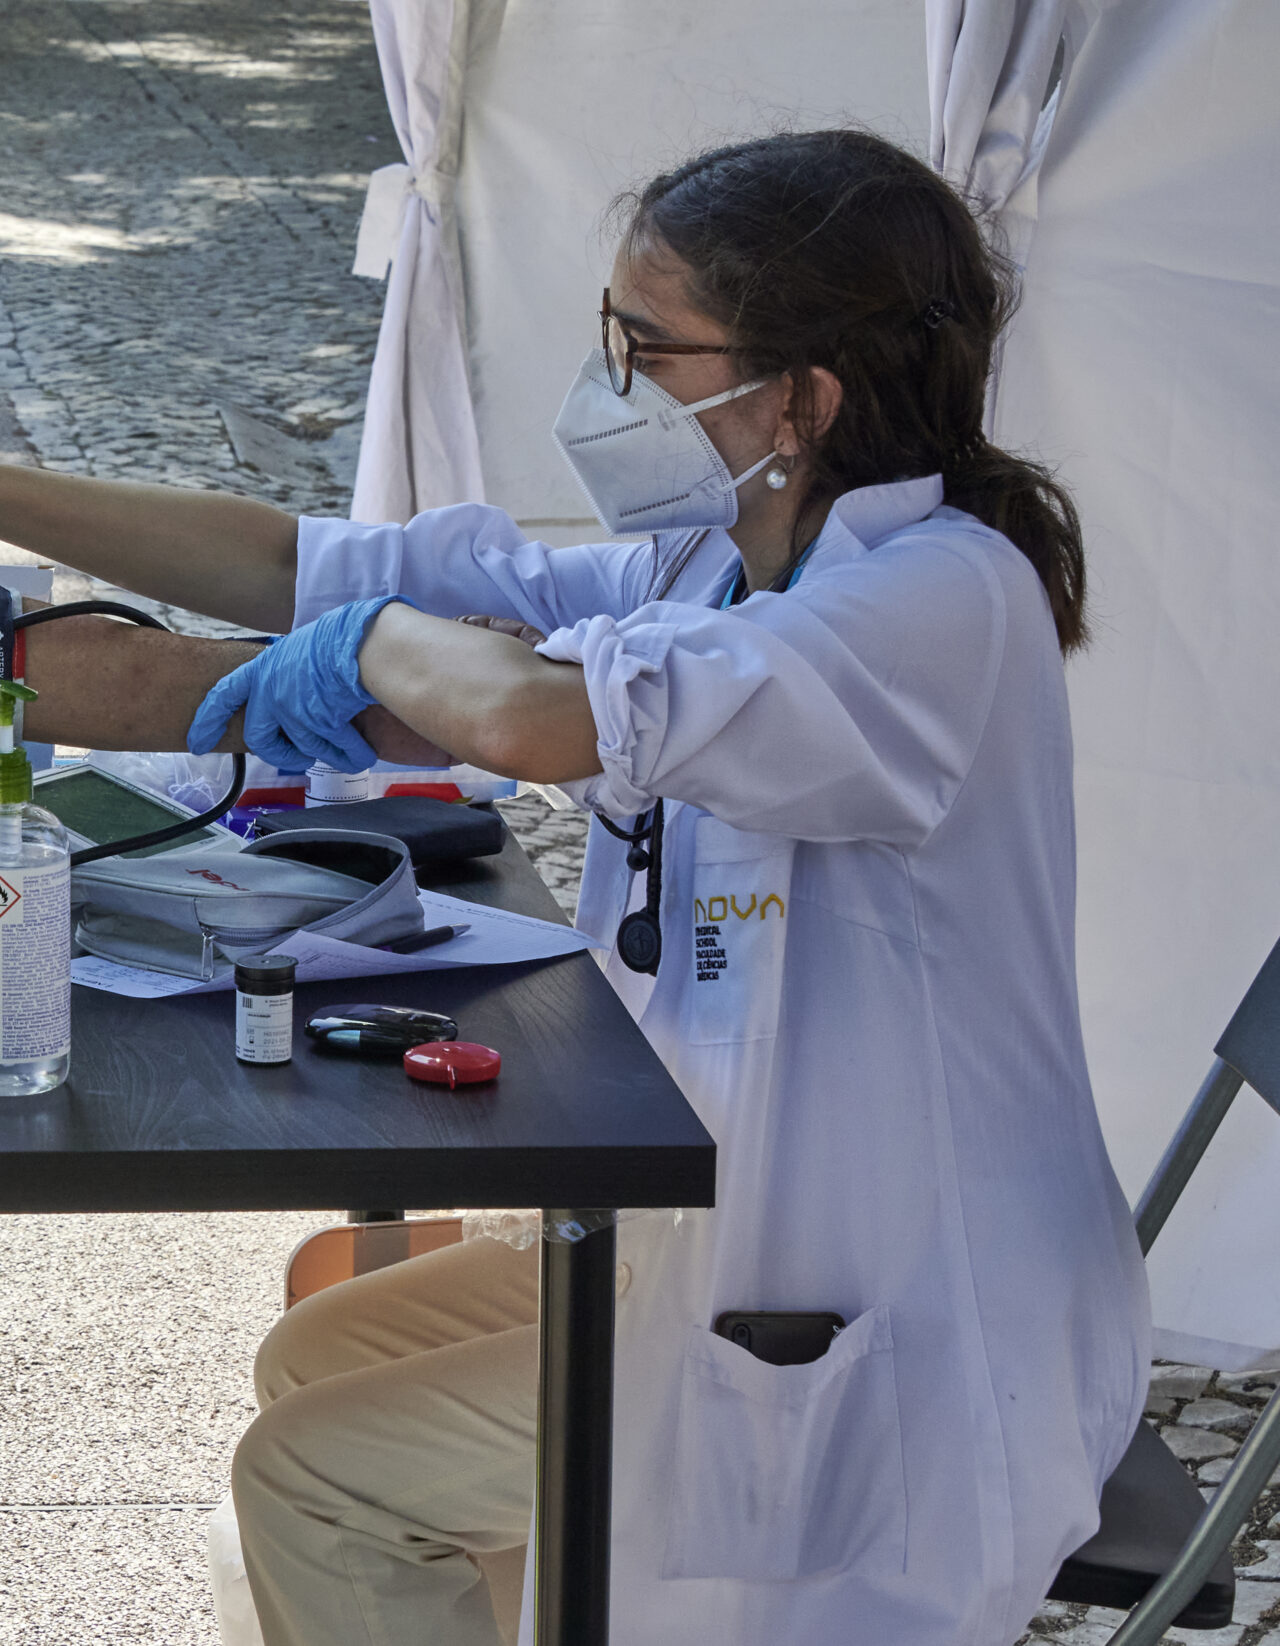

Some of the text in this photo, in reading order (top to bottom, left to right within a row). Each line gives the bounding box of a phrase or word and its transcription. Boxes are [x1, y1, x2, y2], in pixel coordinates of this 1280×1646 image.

[695, 893, 784, 922] NOVA
[695, 926, 720, 936] MEDICAL
[696, 937, 717, 947] SCHOOL
[696, 949, 726, 959] FACULDADE
